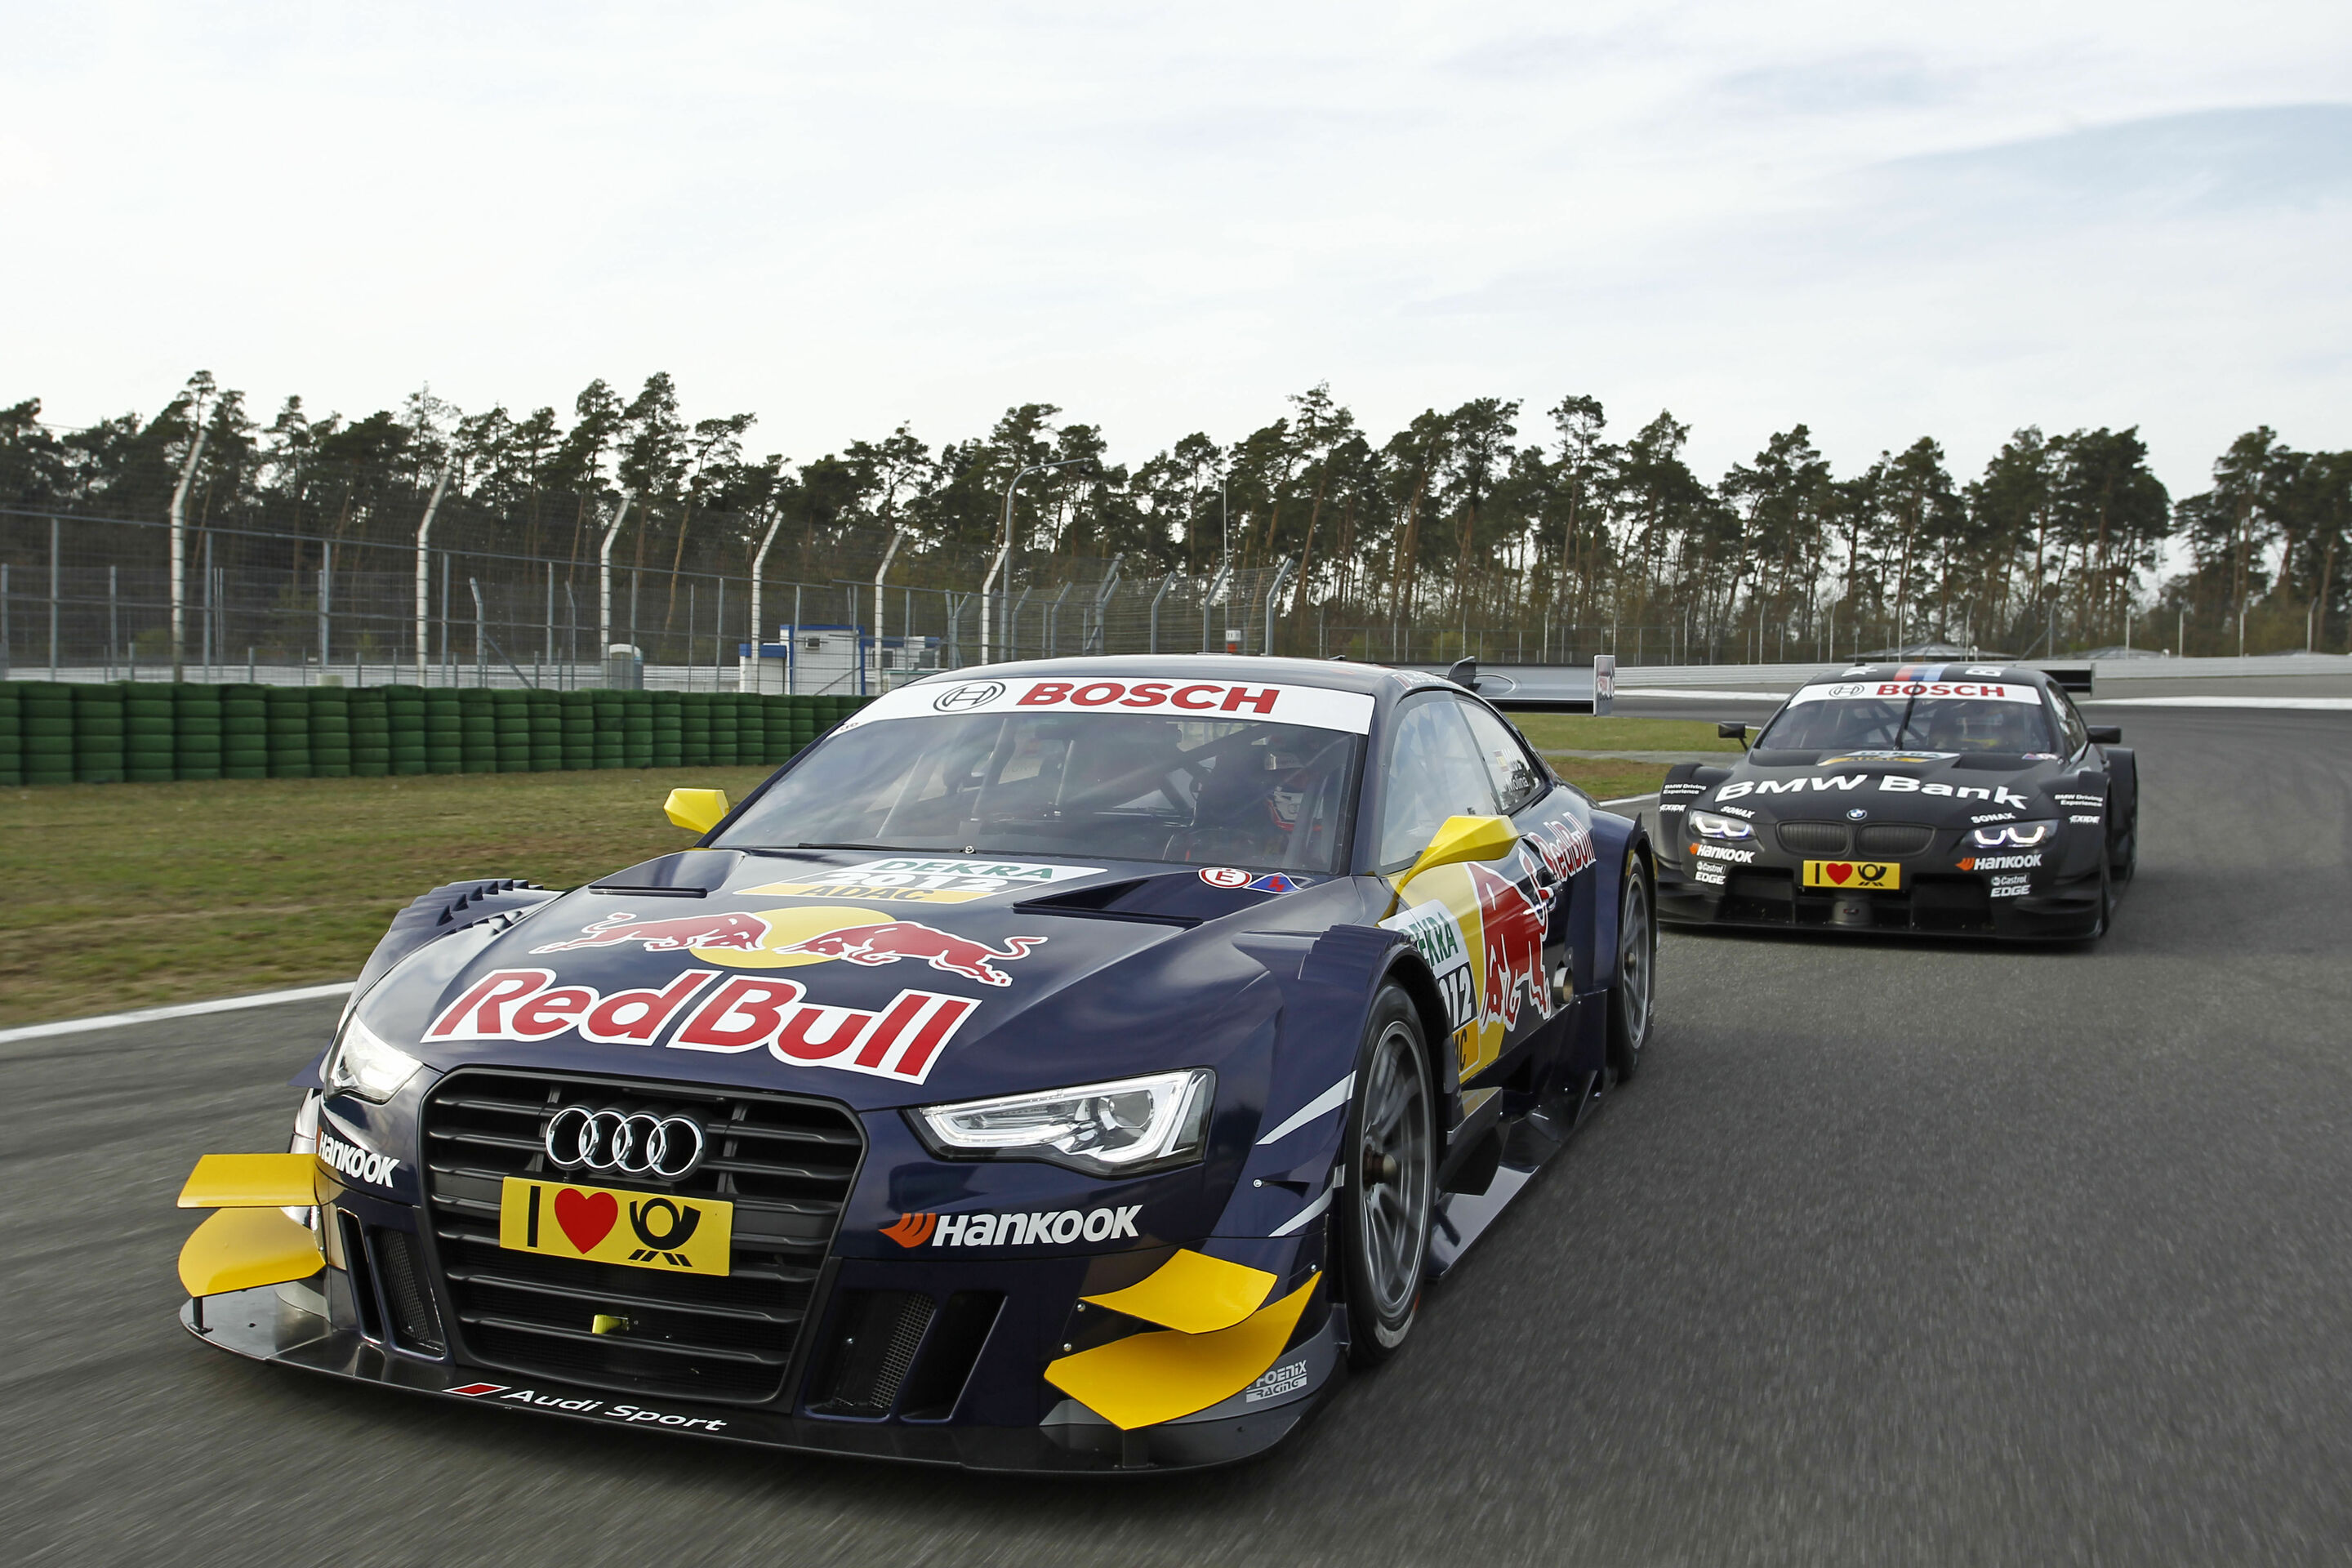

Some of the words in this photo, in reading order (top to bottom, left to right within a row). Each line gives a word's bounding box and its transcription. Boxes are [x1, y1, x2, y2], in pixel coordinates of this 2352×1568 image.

[1877, 684, 2005, 697] BOSCH
[1015, 683, 1281, 715] BOSCH
[1715, 774, 1868, 802] BMW
[1879, 776, 2028, 810] Bank
[1721, 806, 1755, 818] SONAX
[1971, 813, 2016, 823] SONAX
[872, 861, 1054, 879] DEKRA
[1703, 863, 1723, 873] Castrol
[825, 873, 1008, 891] 2012
[1695, 871, 1726, 884] EDGE
[2001, 875, 2026, 884] Castrol
[797, 886, 934, 900] ADAC
[1990, 884, 2031, 898] EDGE
[423, 969, 720, 1045] Red
[666, 974, 982, 1085] Bull
[500, 1390, 603, 1412] Audi
[604, 1405, 728, 1431] Sport
